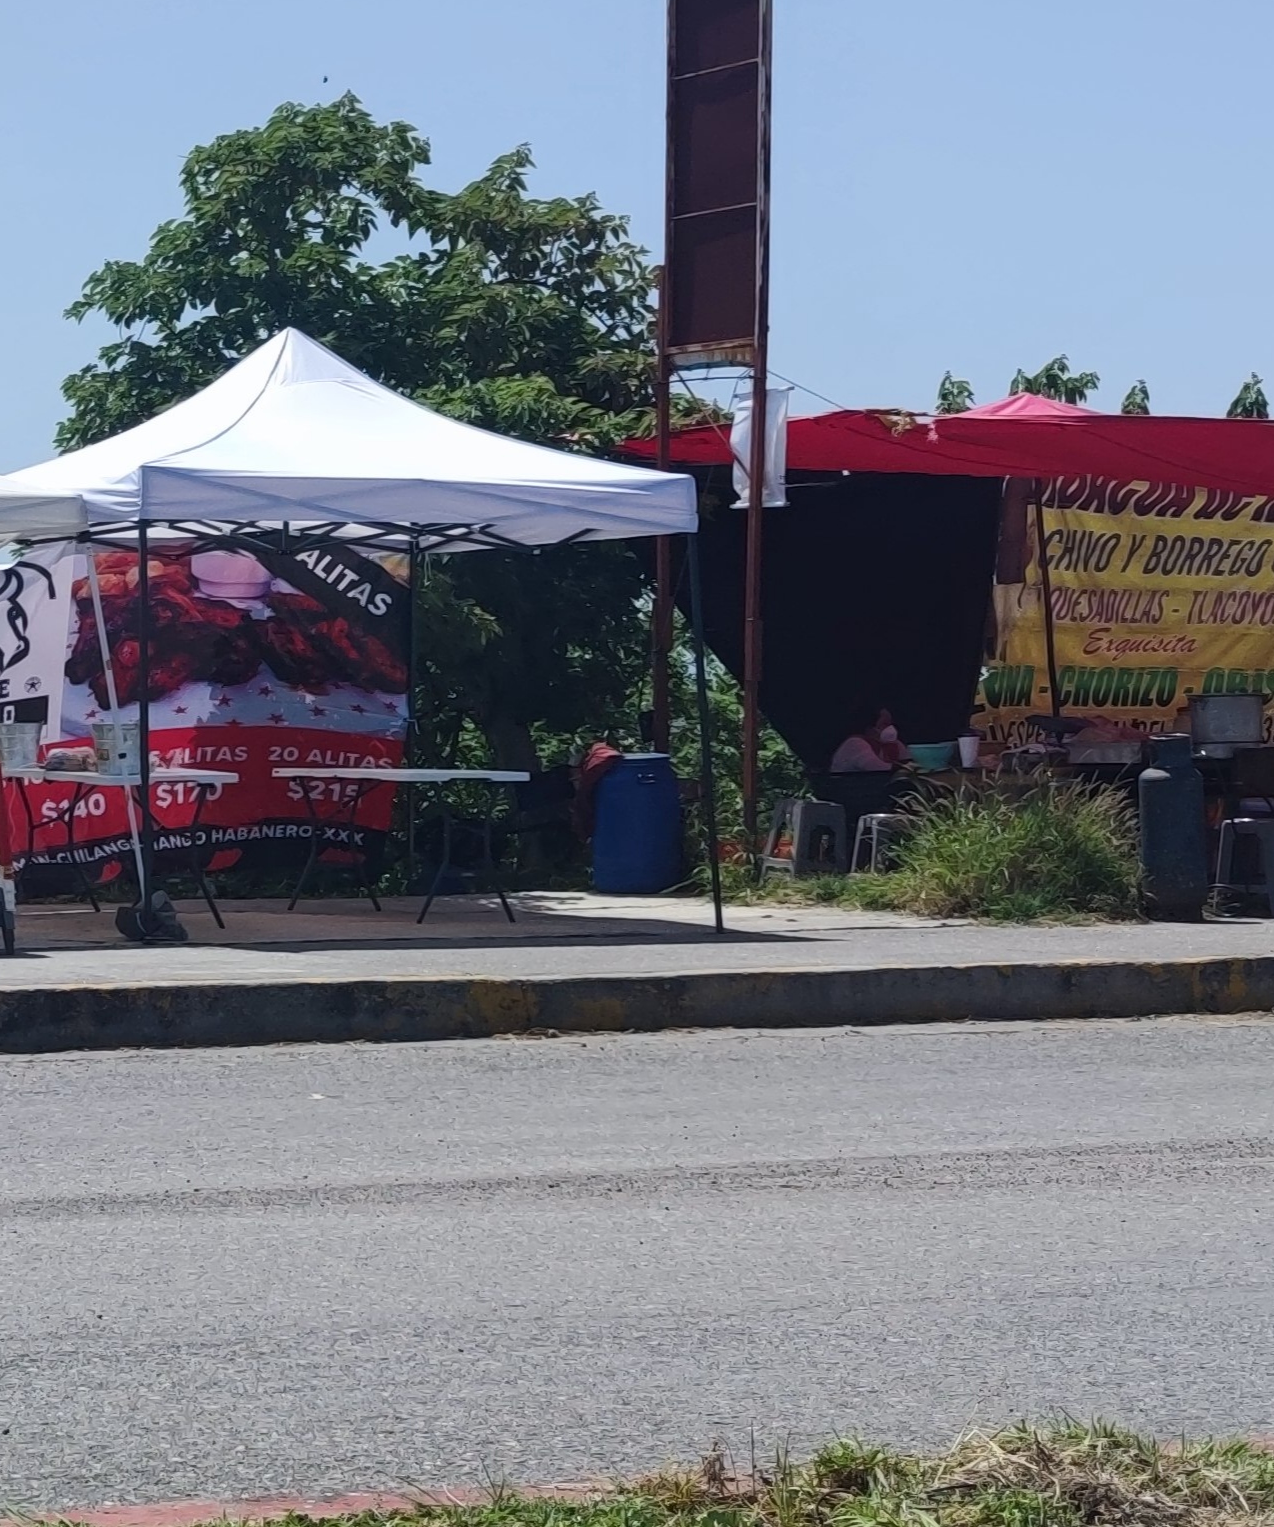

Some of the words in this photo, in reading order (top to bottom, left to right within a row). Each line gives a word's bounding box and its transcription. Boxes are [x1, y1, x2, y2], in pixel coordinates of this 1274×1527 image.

[1038, 528, 1122, 574] CHIVO
[1124, 533, 1147, 574] Y
[1141, 534, 1274, 577] BORREGO
[294, 550, 393, 616] ALITAS
[1083, 628, 1198, 661] Exquisita
[1057, 666, 1177, 708] CHORIZO
[268, 746, 298, 761] 20
[306, 749, 392, 770] ALITAS
[287, 779, 359, 808] $215
